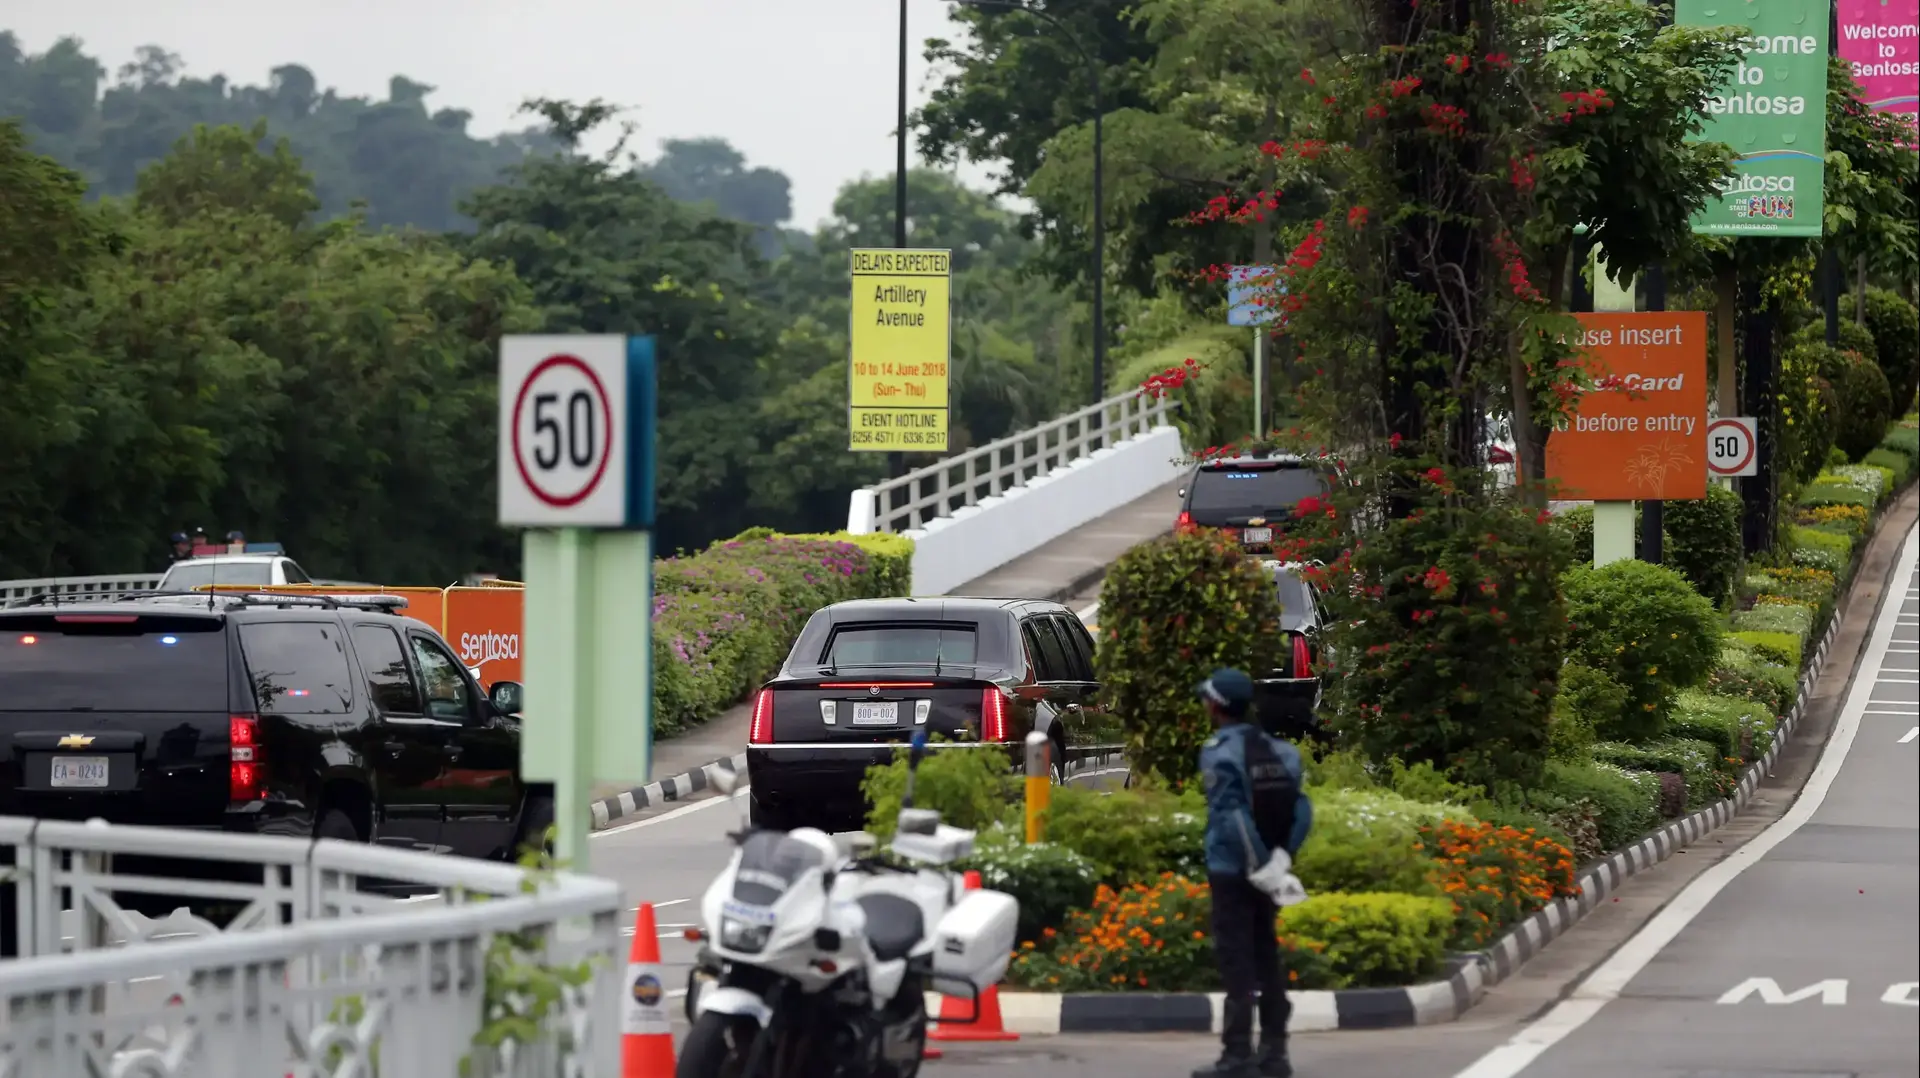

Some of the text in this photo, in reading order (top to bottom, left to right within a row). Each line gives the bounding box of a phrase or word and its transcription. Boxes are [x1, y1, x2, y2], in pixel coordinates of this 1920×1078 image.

[1878, 43, 1896, 58] to
[1738, 61, 1764, 85] to
[1747, 194, 1794, 219] FUN
[1710, 223, 1778, 231] www.sentosa.com
[854, 253, 948, 272] DELAYS EXPECTED
[874, 285, 927, 307] Artillery
[876, 308, 925, 327] Avenue
[1620, 324, 1682, 346] insert
[854, 362, 946, 377] 10 to 14 June 2018
[904, 383, 926, 399] Thu)
[533, 389, 594, 471] 50
[862, 413, 938, 428] EVENT HOTLINE
[1576, 413, 1639, 432] before
[1645, 414, 1696, 435] entry
[852, 431, 873, 444] 6256
[875, 431, 895, 444] 4571
[926, 432, 946, 444] 2517
[1714, 436, 1739, 458] 50
[857, 708, 895, 719] 800 002
